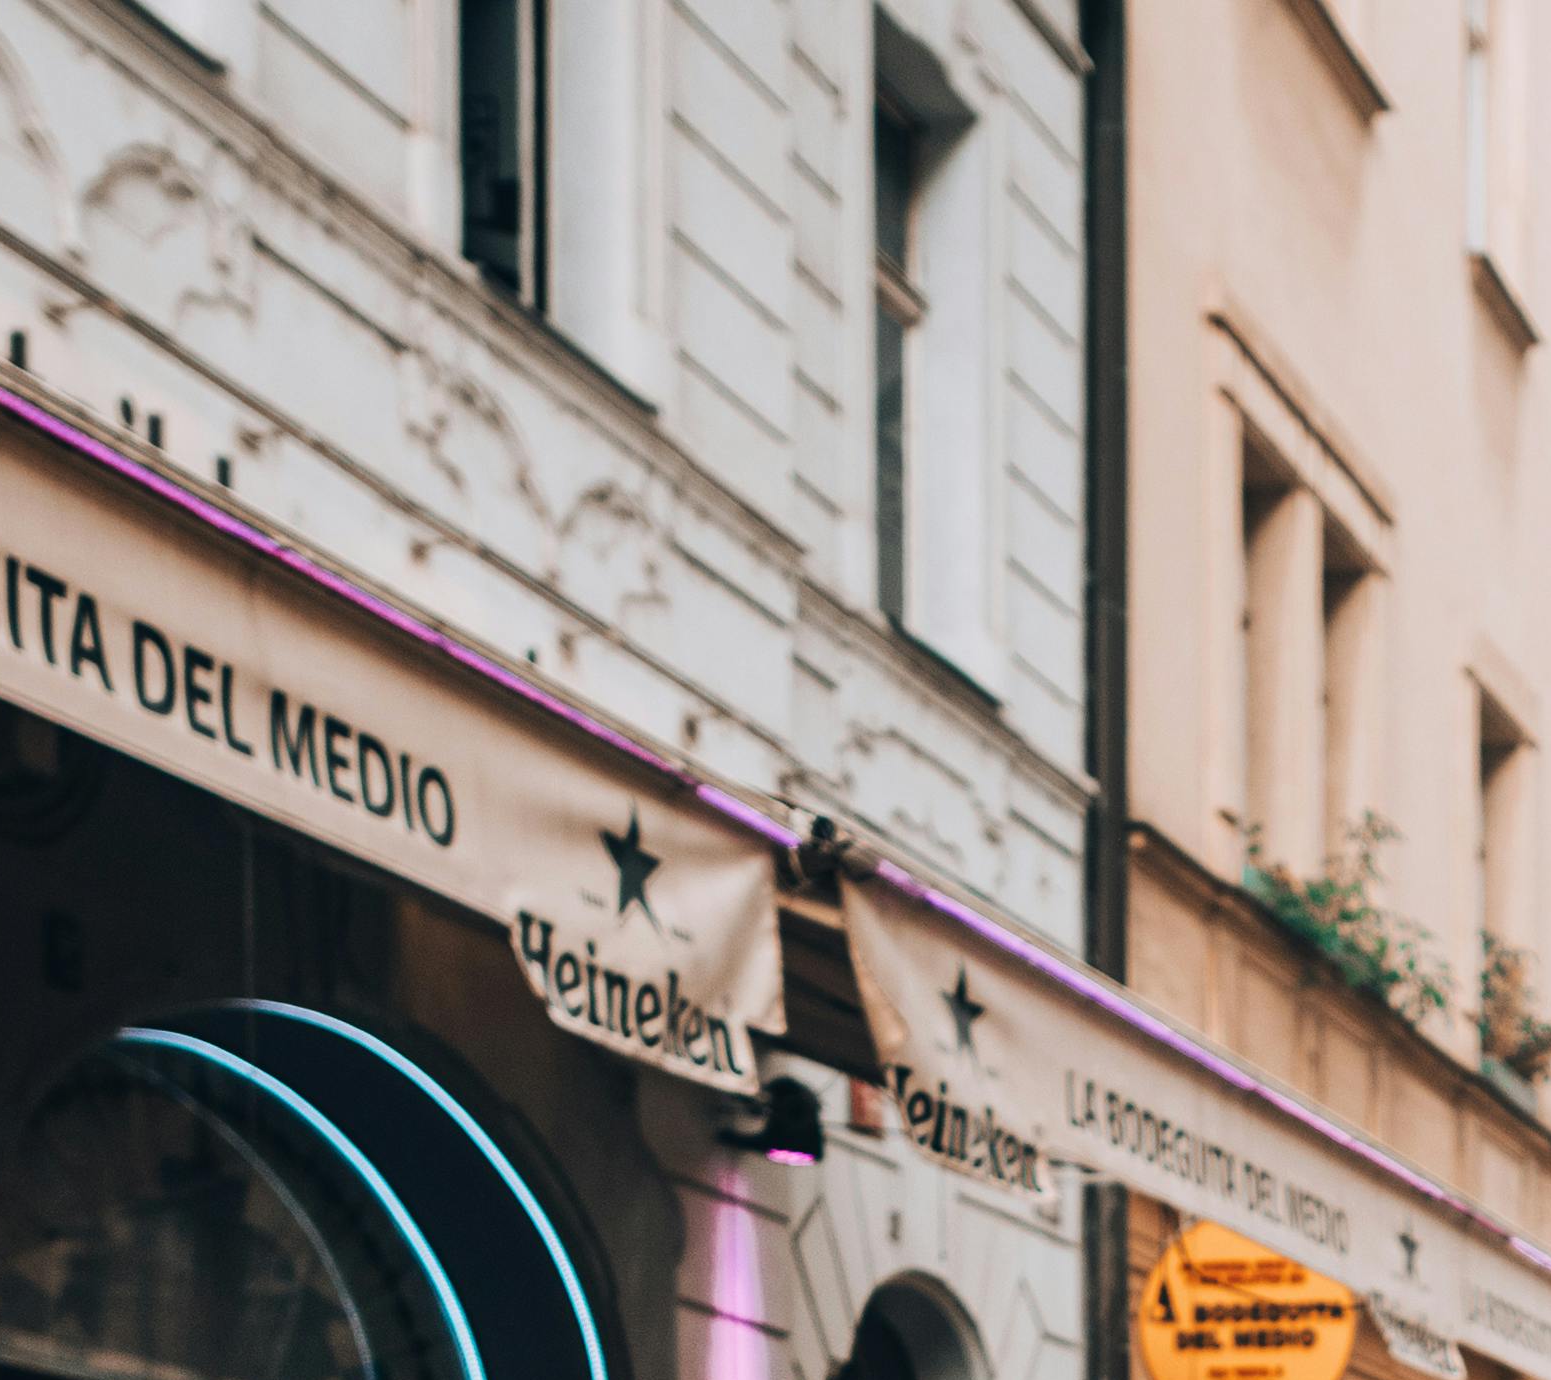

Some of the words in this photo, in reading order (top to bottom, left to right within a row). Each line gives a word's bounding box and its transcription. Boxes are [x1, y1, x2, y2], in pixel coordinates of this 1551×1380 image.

[131, 619, 255, 758] DEL
[269, 689, 456, 848] MEDIO
[510, 908, 745, 1076] Heineken
